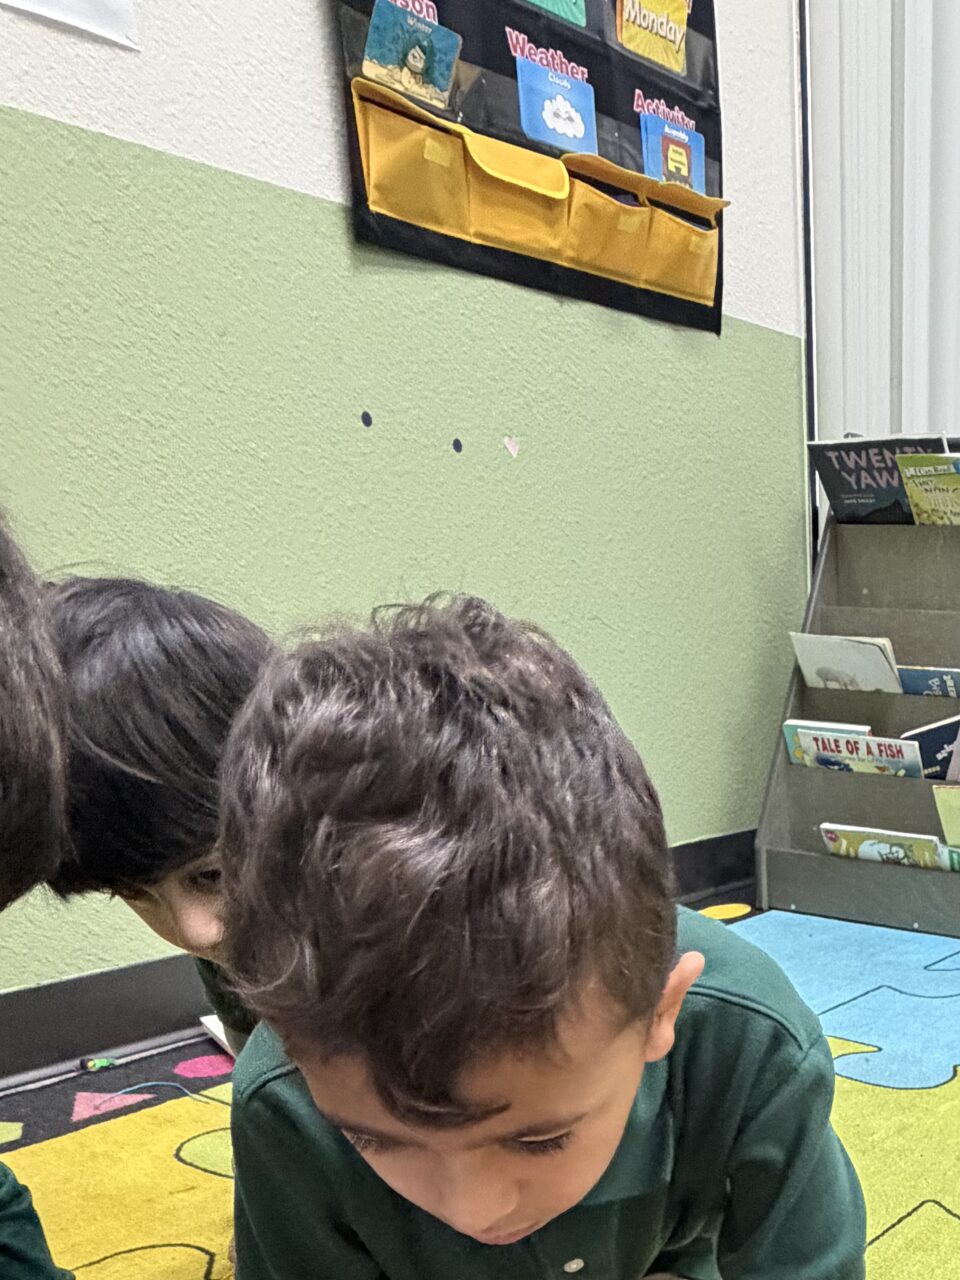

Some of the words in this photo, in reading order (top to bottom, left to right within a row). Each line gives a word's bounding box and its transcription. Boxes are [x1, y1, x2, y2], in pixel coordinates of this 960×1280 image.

[392, 0, 438, 25] son
[625, 0, 684, 53] Monday
[505, 26, 589, 83] Weather
[633, 88, 696, 132] Activity
[812, 736, 842, 755] TALE
[845, 739, 860, 756] OF
[865, 741, 874, 757] A
[876, 742, 905, 759] FISH
